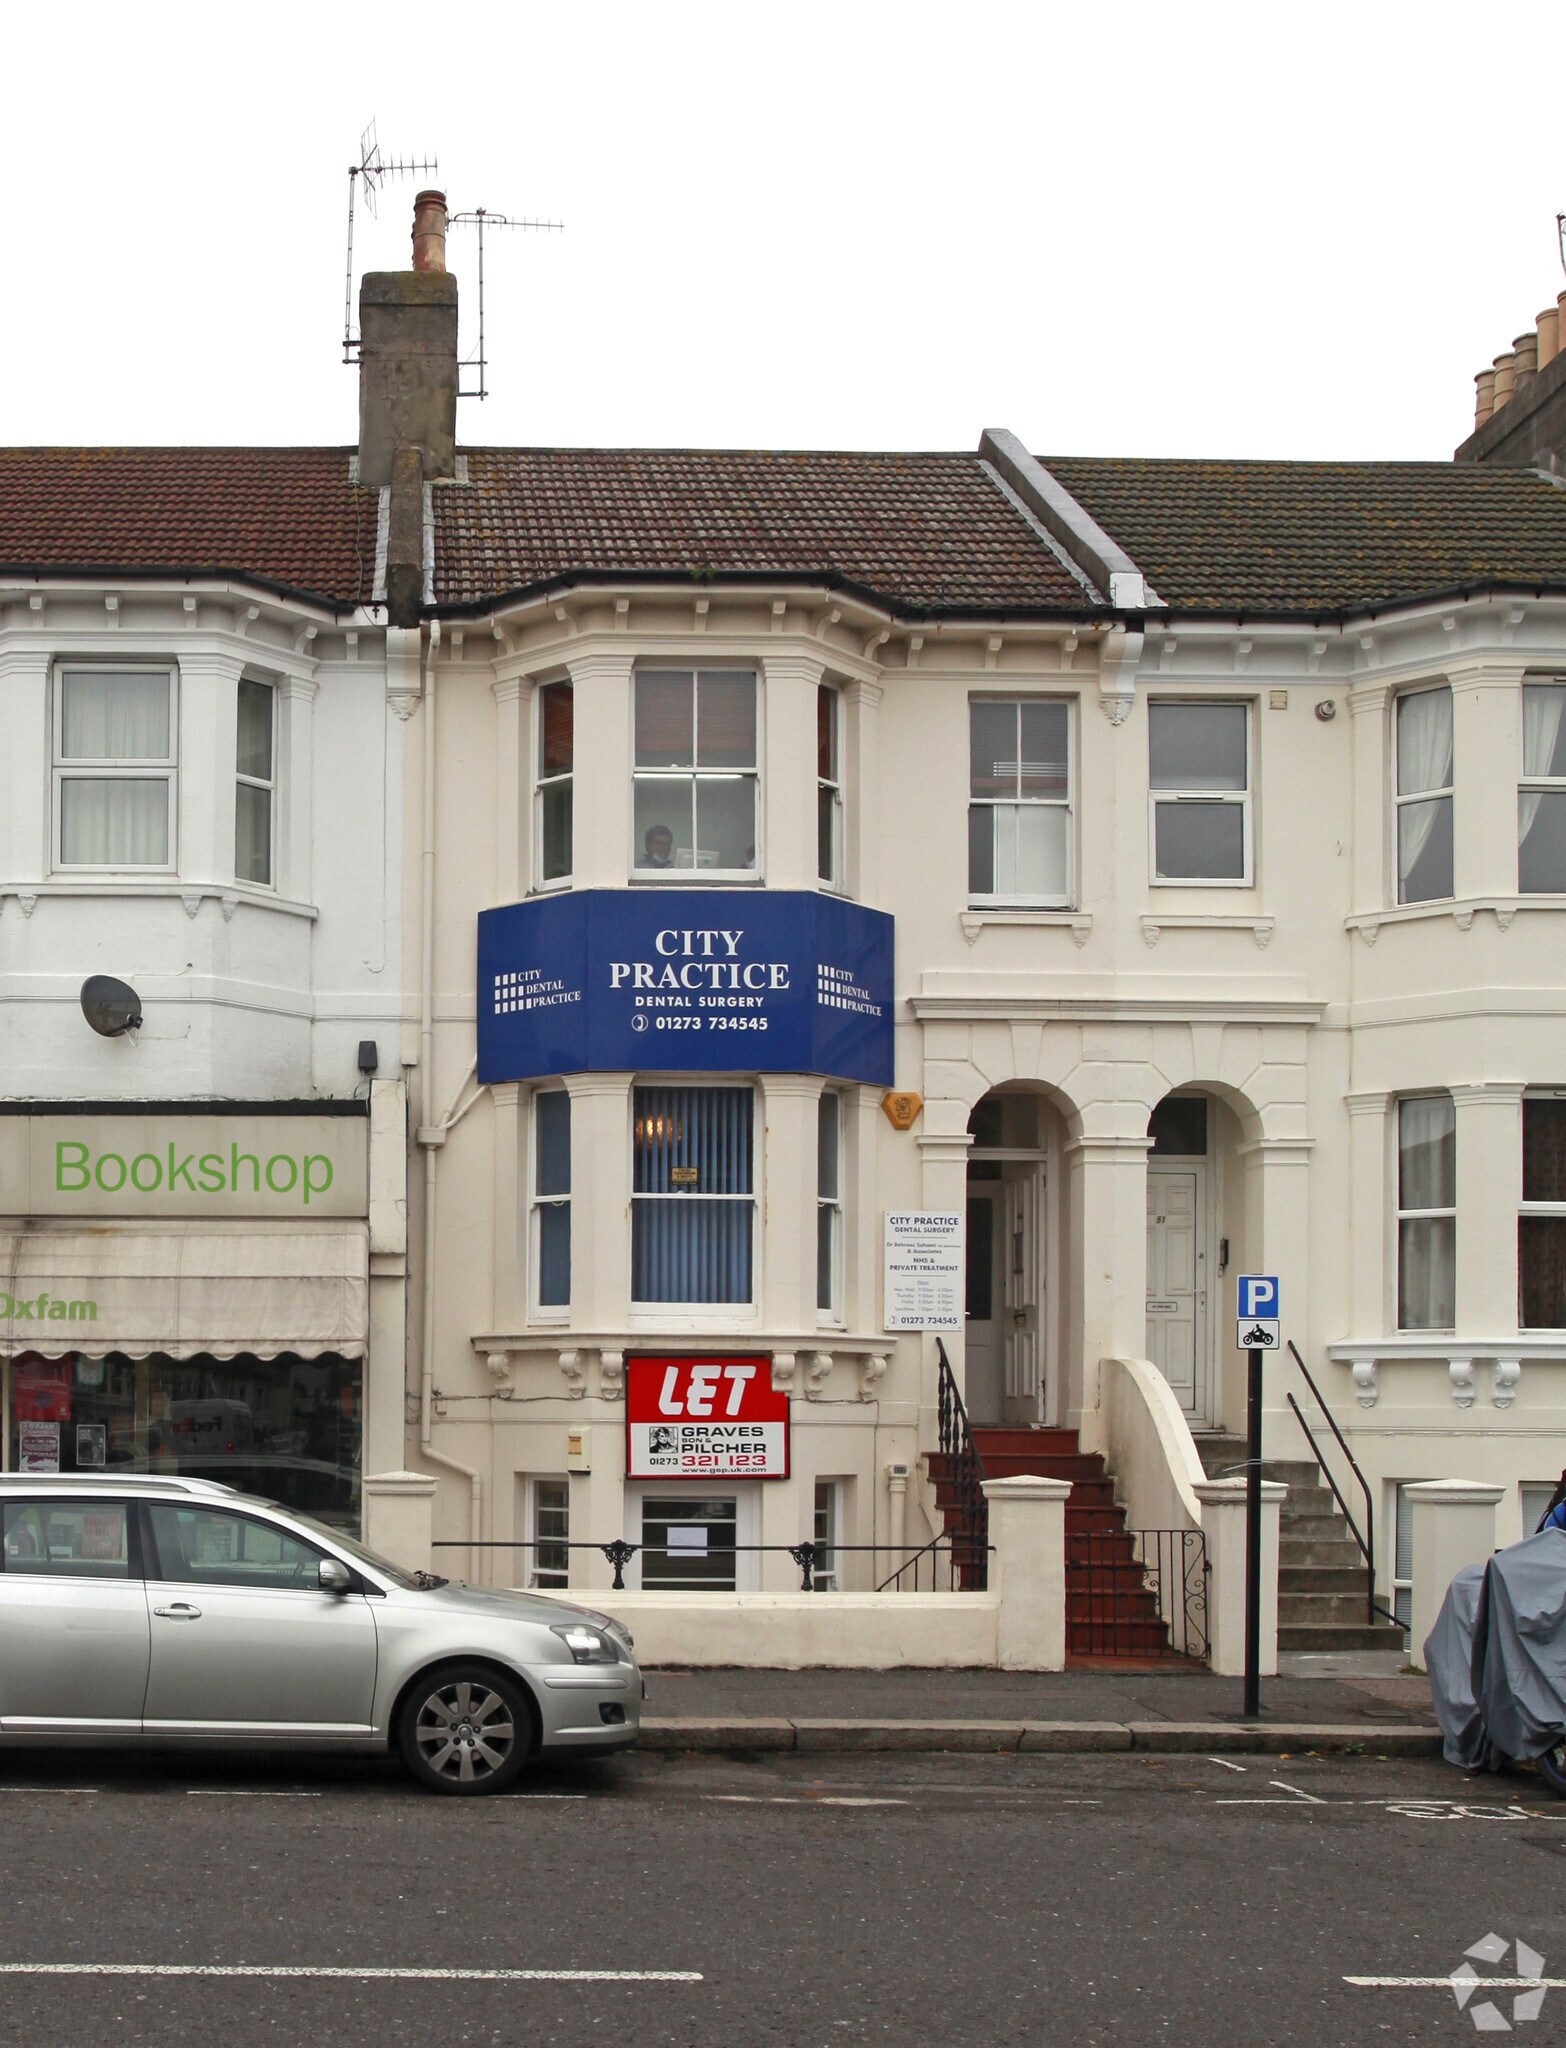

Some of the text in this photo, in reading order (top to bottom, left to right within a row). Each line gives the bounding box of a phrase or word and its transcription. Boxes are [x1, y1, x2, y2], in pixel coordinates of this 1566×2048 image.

[655, 930, 744, 956] CITY
[518, 969, 541, 982] CITY
[609, 963, 790, 989] PRACTICE
[836, 970, 854, 982] CITY
[526, 980, 564, 995] DENTAL
[842, 985, 870, 1000] DENTAL
[533, 991, 581, 1007] PRACTICE
[635, 996, 764, 1007] DENTAL SURGERY
[847, 1000, 882, 1016] PRACTICE
[655, 1017, 768, 1030] 01273 734545
[55, 1141, 334, 1204] Bookshop
[889, 1217, 959, 1225] CITY PRACTICE
[1156, 1216, 1166, 1224] 51
[1247, 1280, 1274, 1315] P
[658, 1365, 756, 1416] LET
[681, 1427, 764, 1437] GRAVES
[681, 1444, 767, 1454] PILCHER
[681, 1455, 718, 1466] 321
[729, 1455, 767, 1466] 123
